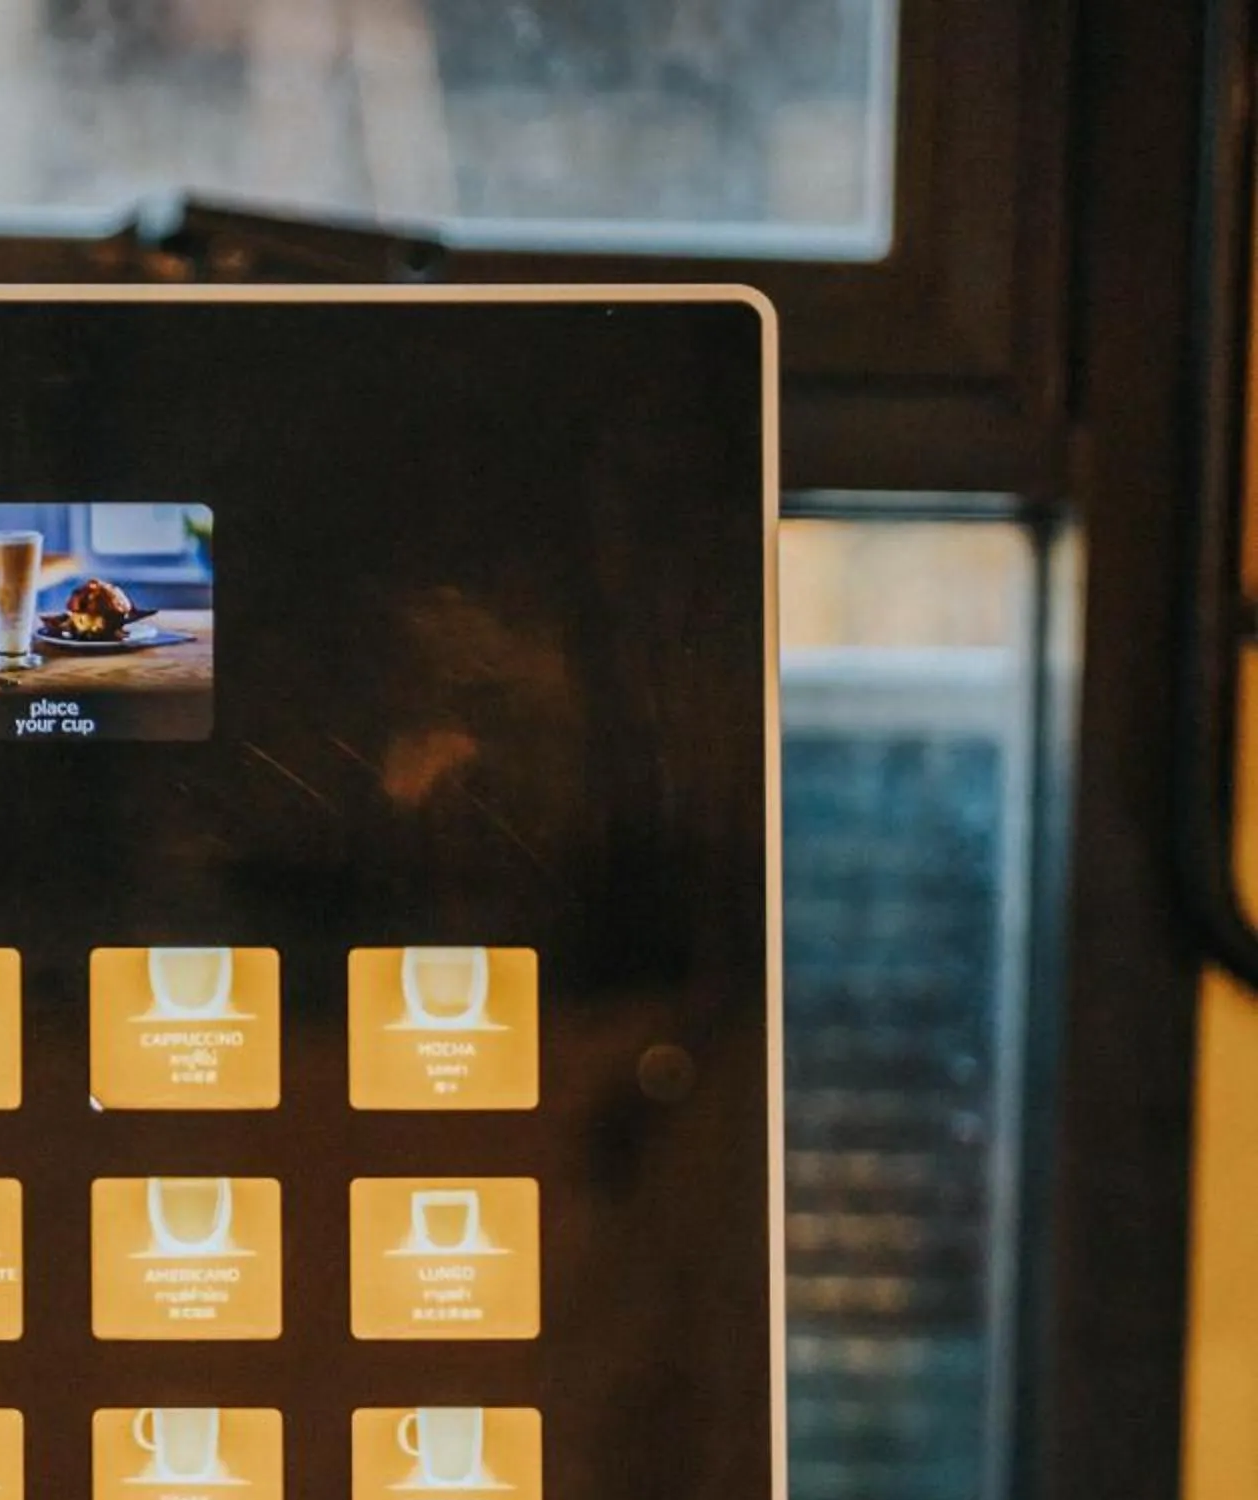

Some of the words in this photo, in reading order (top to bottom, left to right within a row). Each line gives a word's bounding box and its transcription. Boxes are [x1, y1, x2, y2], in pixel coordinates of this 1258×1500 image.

[30, 698, 80, 718] place
[15, 719, 57, 736] your
[61, 719, 95, 736] cup
[139, 1030, 244, 1048] CAPPUCCINO
